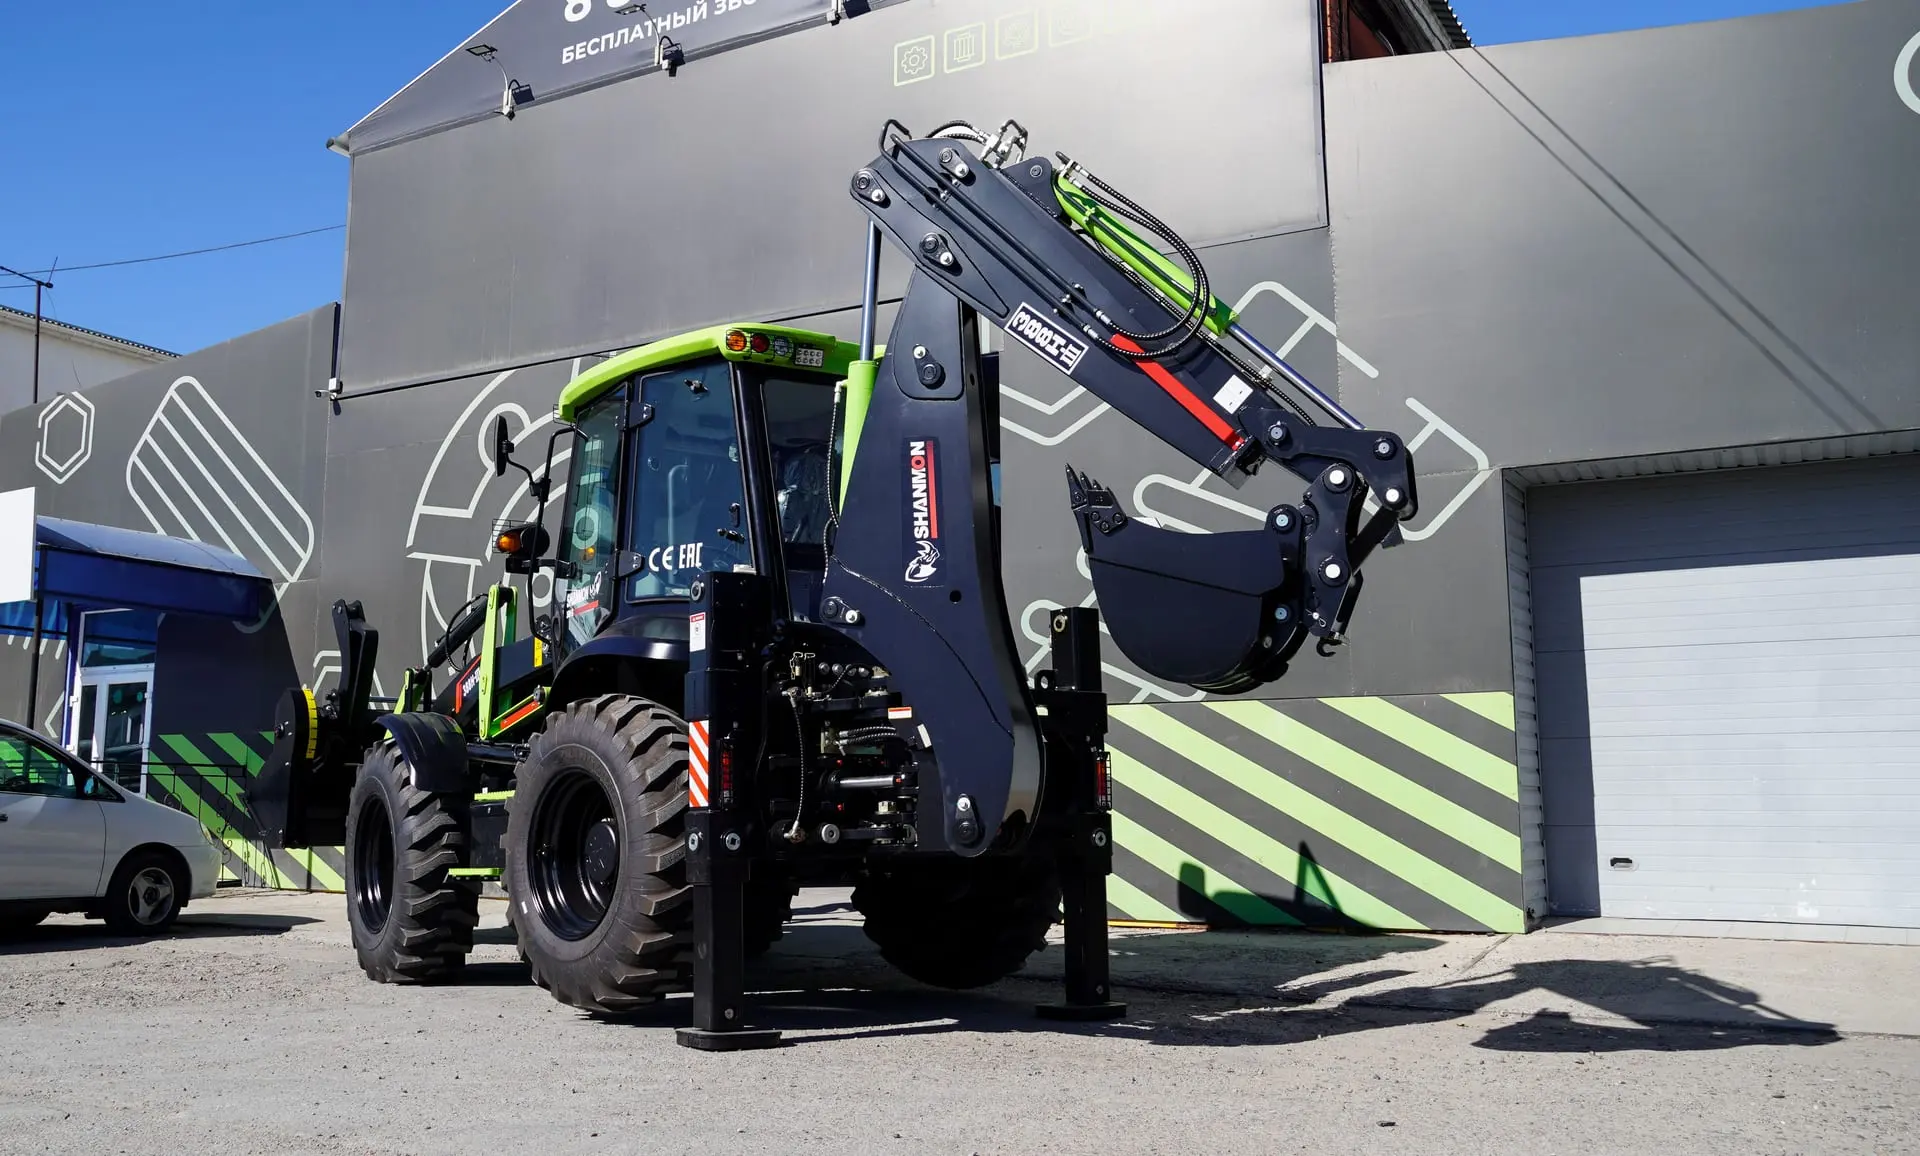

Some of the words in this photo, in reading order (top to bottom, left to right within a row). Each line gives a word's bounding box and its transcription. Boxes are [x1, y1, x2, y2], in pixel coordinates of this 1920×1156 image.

[562, 0, 708, 64] БЕСПЛАТНЫЙ
[714, 0, 758, 15] ЗВ
[910, 441, 930, 539] SHANMON
[649, 545, 674, 572] CE
